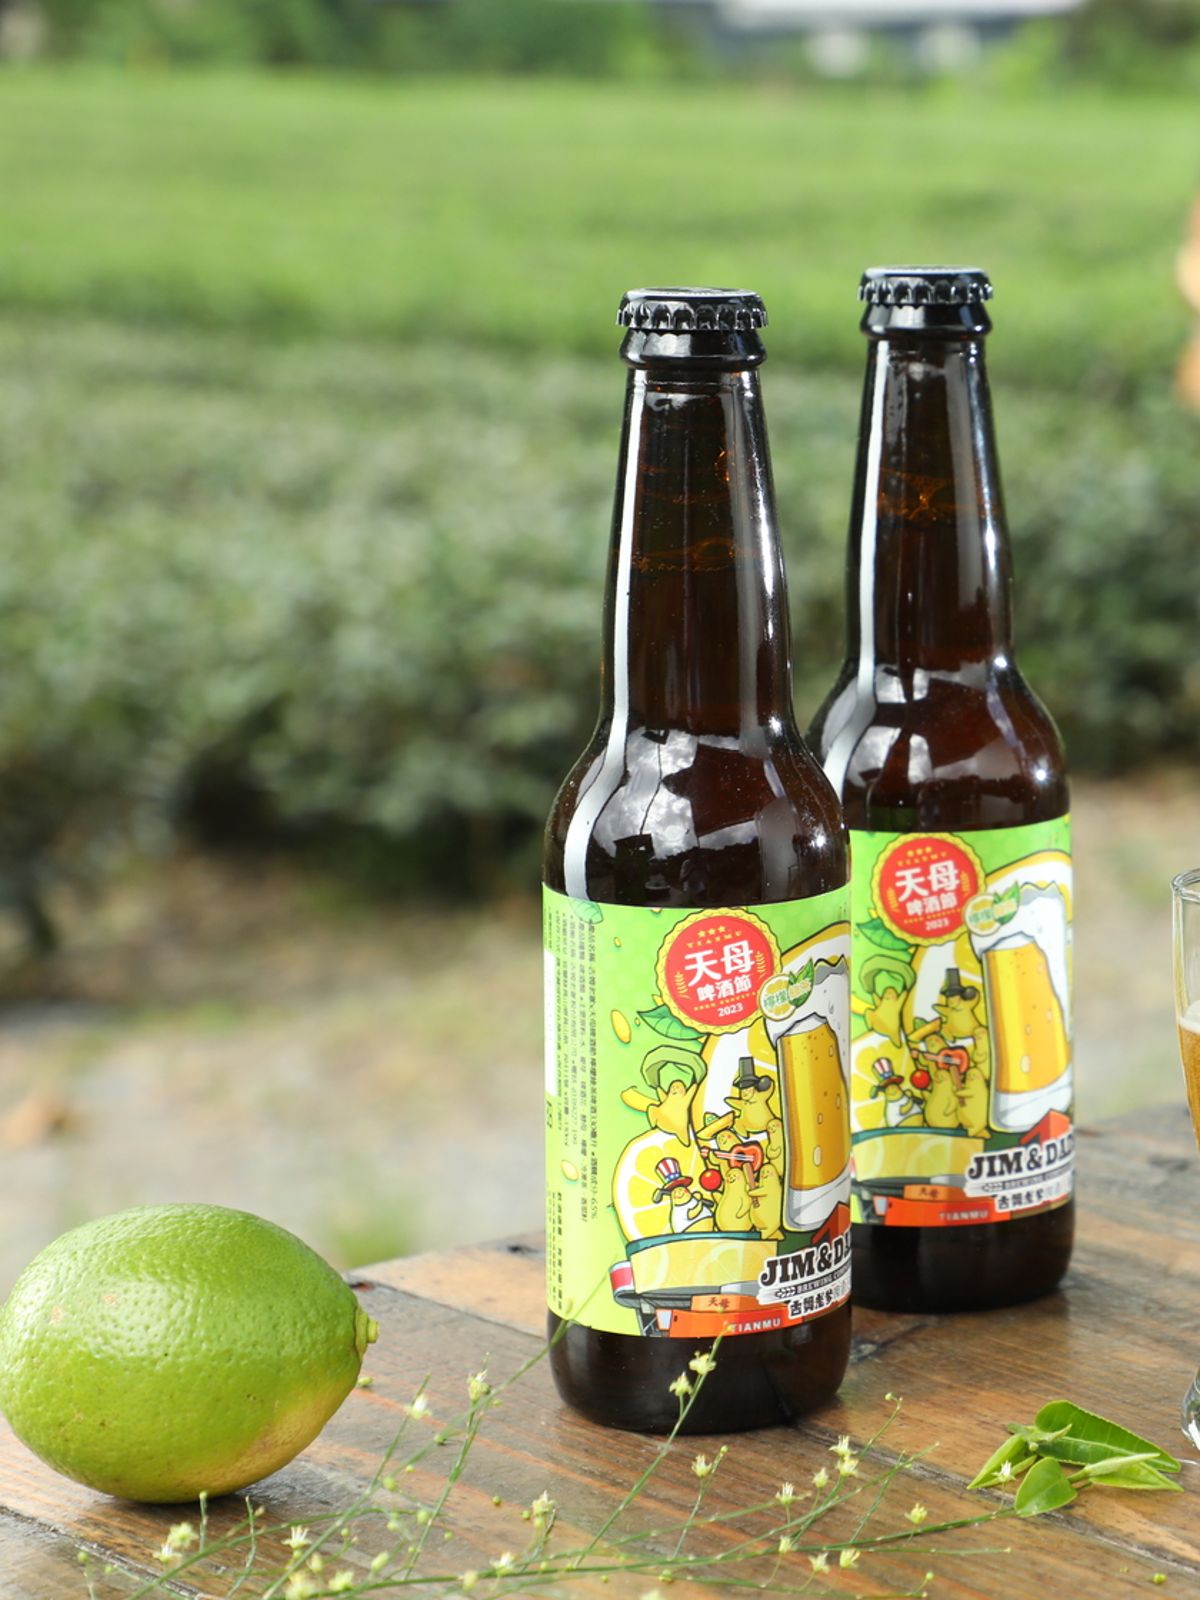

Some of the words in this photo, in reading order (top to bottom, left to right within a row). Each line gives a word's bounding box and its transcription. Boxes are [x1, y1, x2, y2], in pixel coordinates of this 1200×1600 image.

[895, 860, 960, 902] 天母
[684, 940, 755, 987] 天母
[696, 974, 752, 1003] 啤酒節
[717, 1001, 744, 1018] 2023
